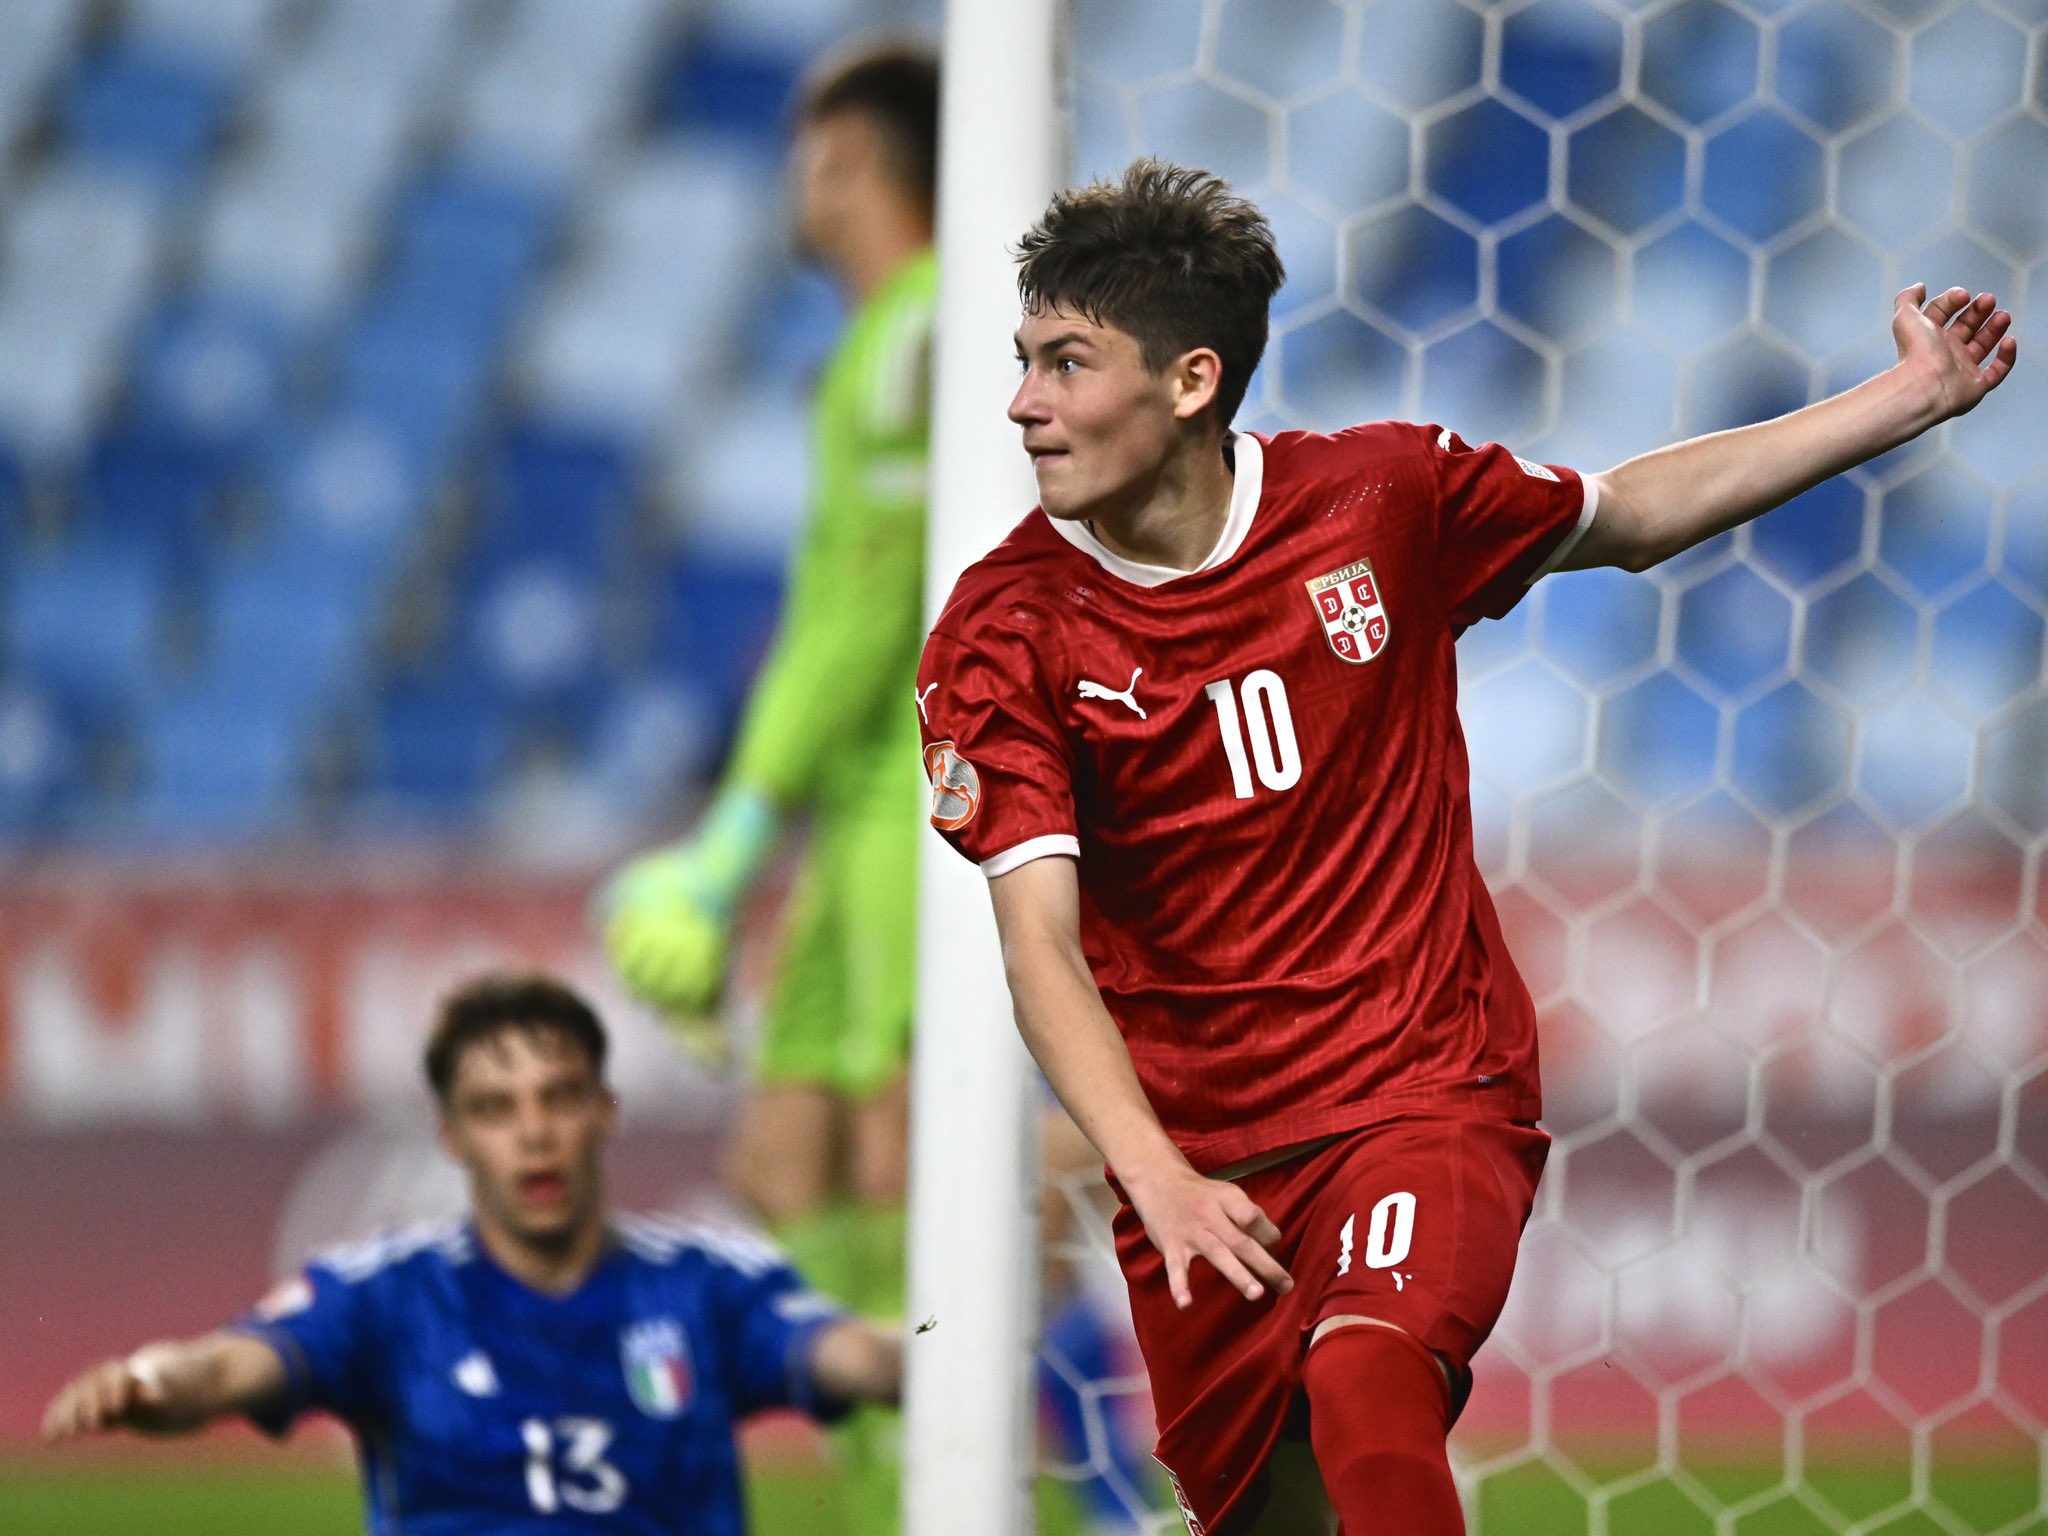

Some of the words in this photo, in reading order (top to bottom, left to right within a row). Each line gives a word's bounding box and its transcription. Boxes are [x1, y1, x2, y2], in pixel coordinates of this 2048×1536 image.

[1311, 563, 1368, 590] СРБИЈА
[1205, 670, 1302, 798] 10
[1336, 1192, 1417, 1277] 10
[521, 1417, 627, 1513] 13
